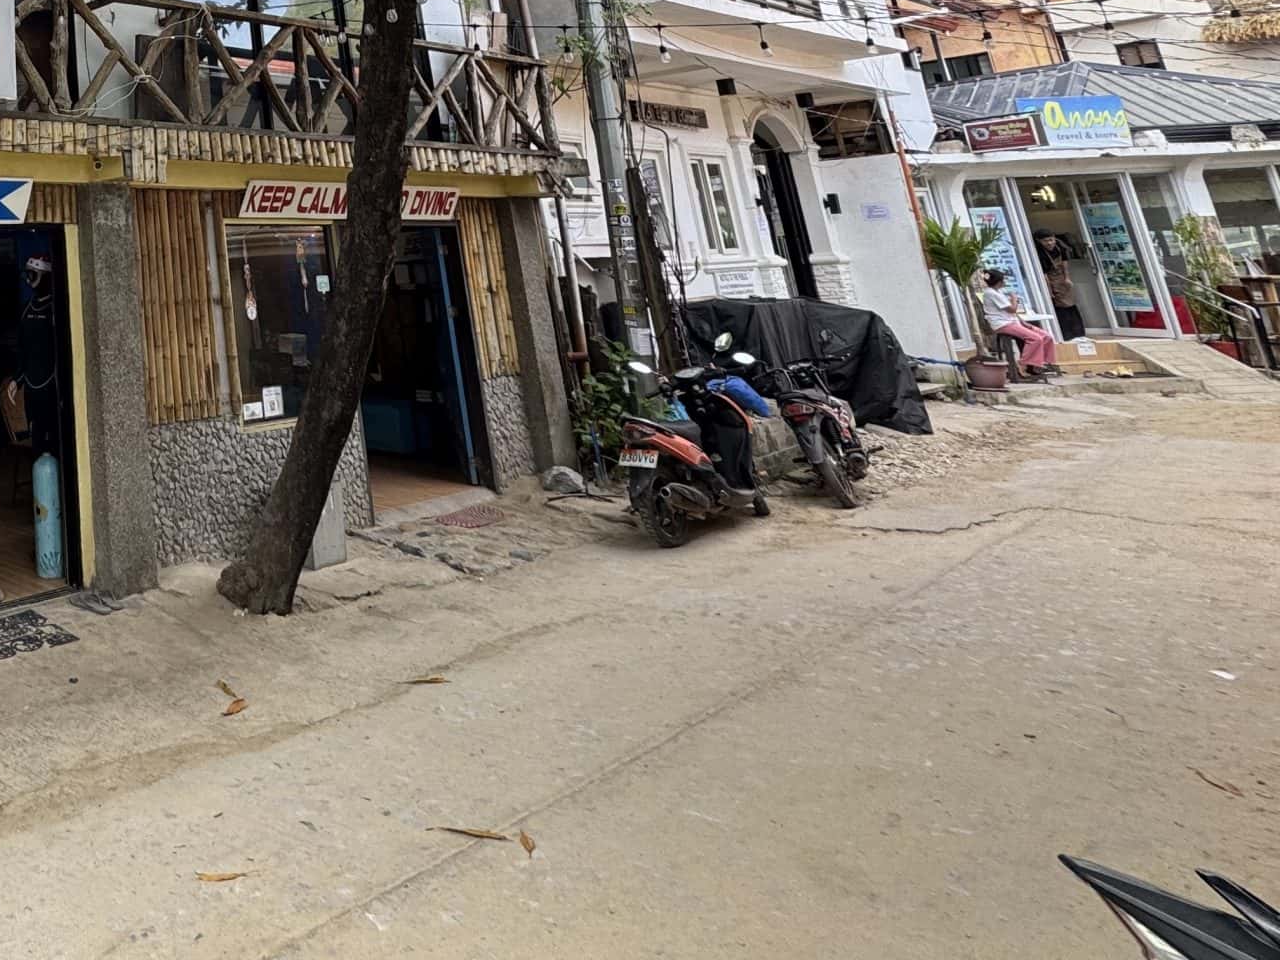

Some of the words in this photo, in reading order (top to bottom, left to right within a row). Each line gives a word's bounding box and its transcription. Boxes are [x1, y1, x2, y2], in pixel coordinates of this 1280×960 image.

[1057, 132, 1083, 140] travel
[245, 185, 296, 213] KEEP
[296, 186, 348, 214] CALM
[409, 191, 456, 216] DIVING
